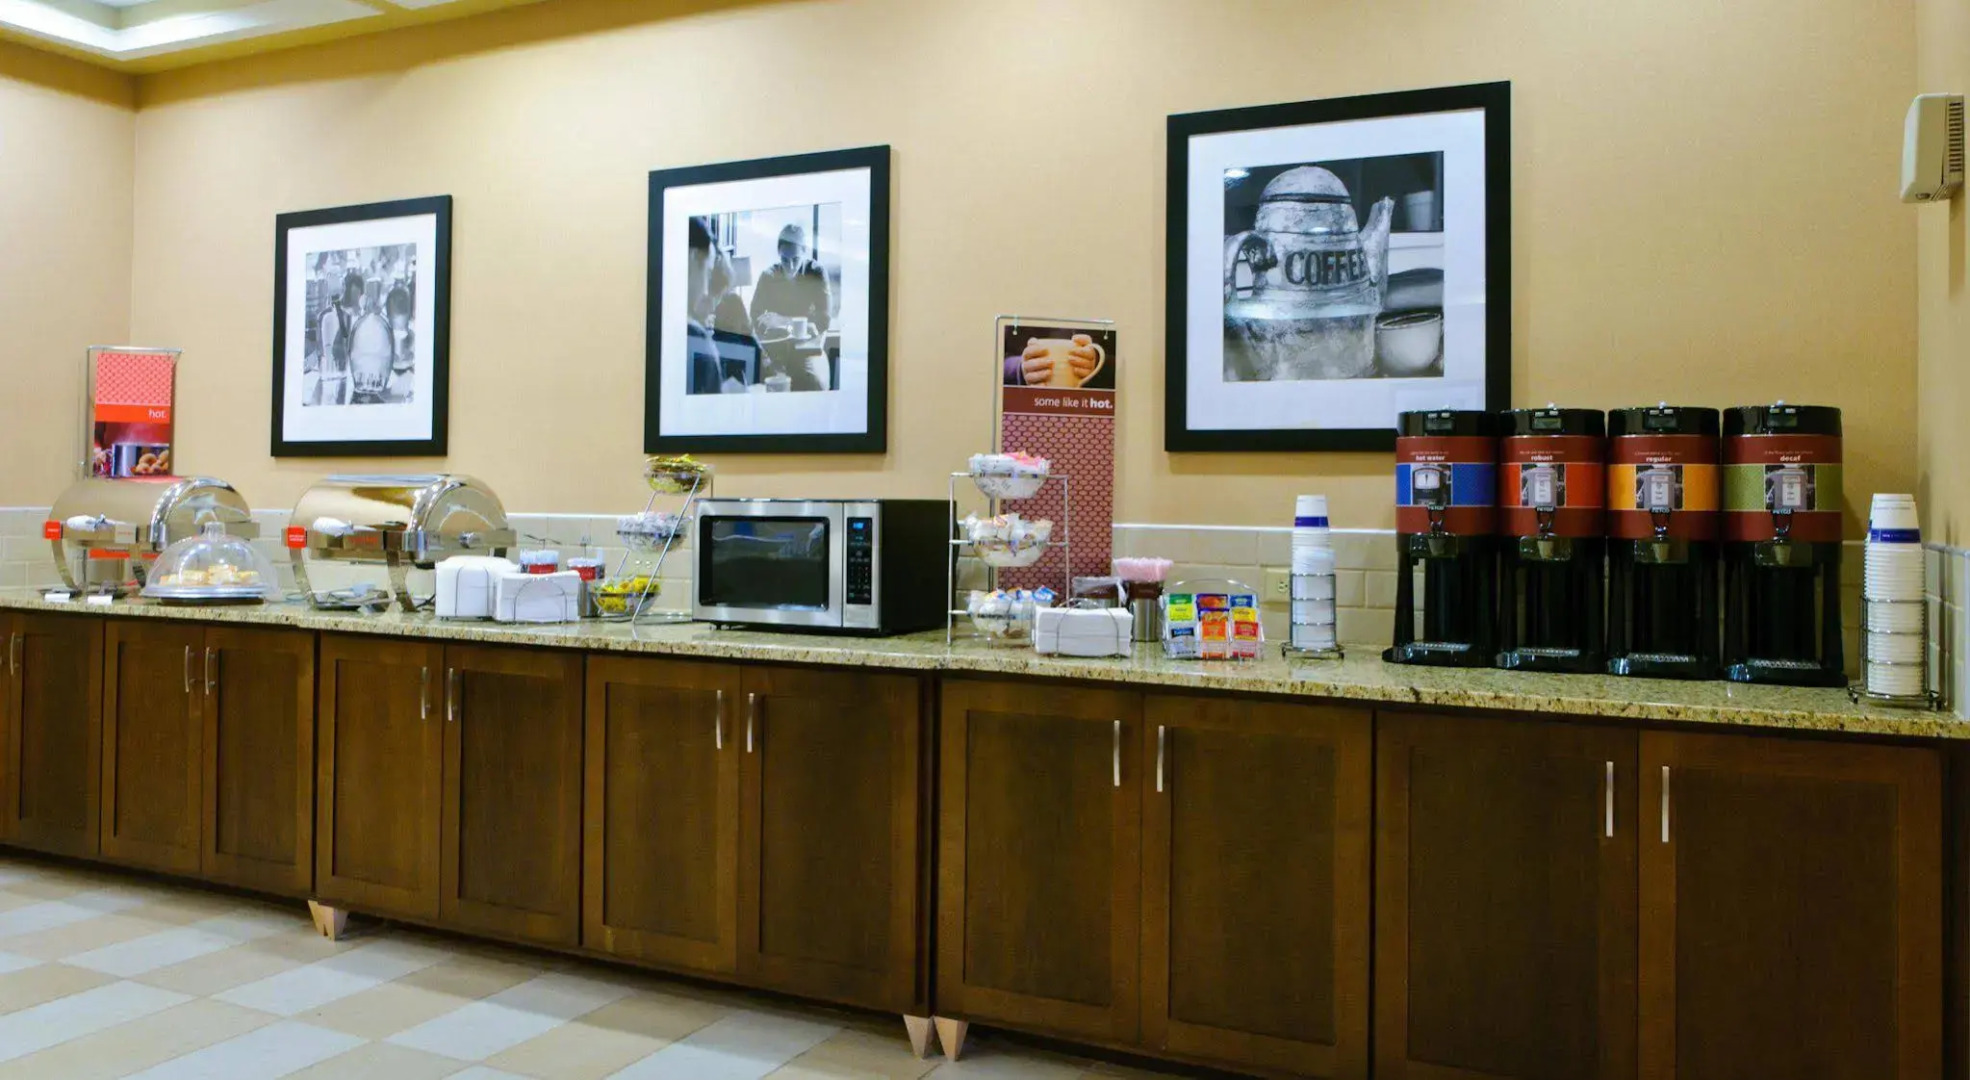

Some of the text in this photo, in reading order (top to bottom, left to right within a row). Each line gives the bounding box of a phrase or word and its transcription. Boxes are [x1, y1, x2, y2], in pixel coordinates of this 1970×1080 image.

[1284, 251, 1368, 286] COFFEE
[1034, 396, 1113, 409] some like it hot.
